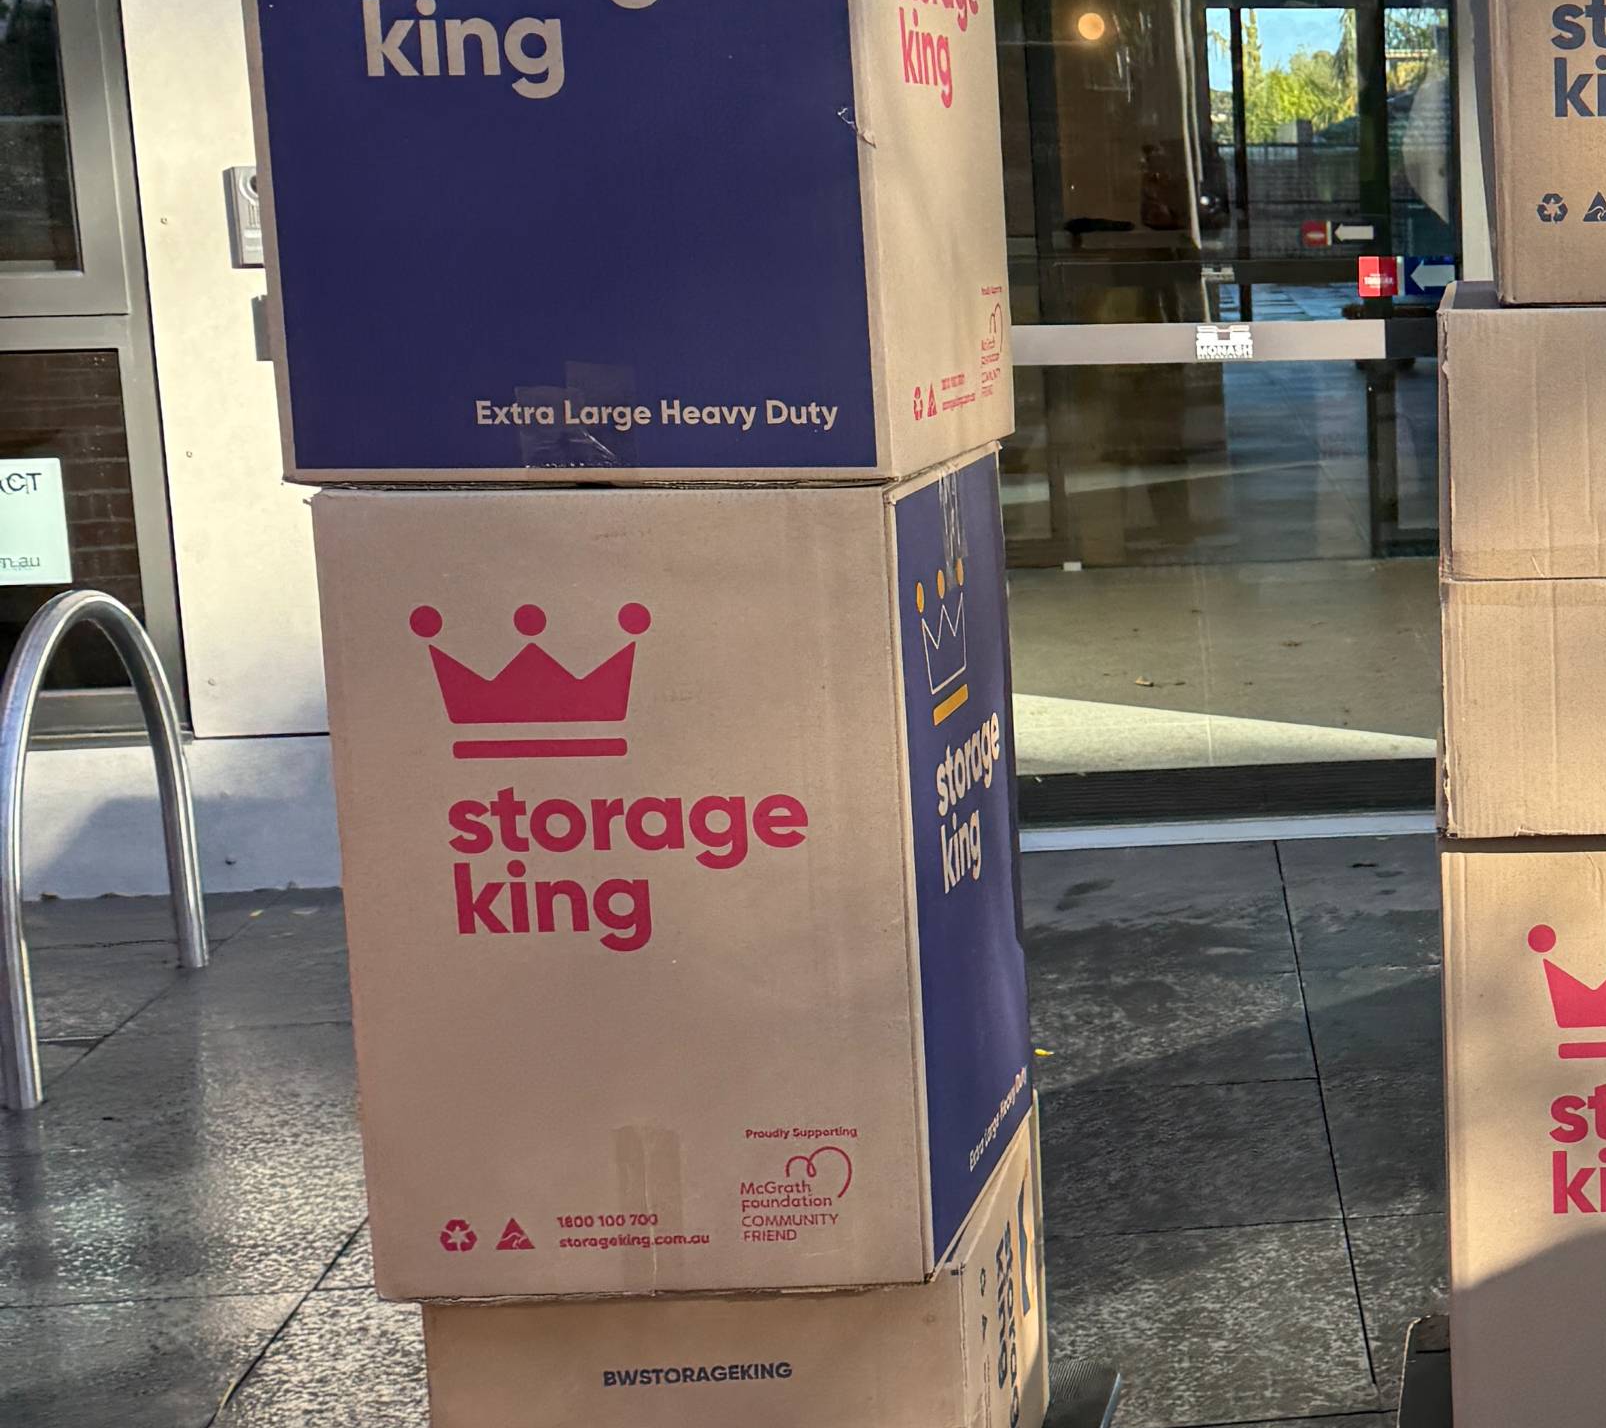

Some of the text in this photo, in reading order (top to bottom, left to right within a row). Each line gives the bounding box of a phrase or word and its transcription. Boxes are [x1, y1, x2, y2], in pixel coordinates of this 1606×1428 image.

[898, 6, 953, 109] king
[475, 399, 839, 431] Extra Large Heavy Duty
[936, 712, 1000, 817] storage
[447, 786, 810, 870] storage
[940, 809, 982, 894] king
[453, 859, 653, 952] king
[745, 1125, 858, 1140] Proudly Supporting
[740, 1180, 812, 1196] McGrath
[741, 1194, 833, 1212] Foundation
[557, 1213, 659, 1228] 1800 100 700
[741, 1213, 840, 1228] COMMUNITY
[559, 1233, 711, 1249] storageking.com.au
[743, 1229, 798, 1243] FRIEND
[603, 1362, 793, 1387] BWSTORAGEKING
